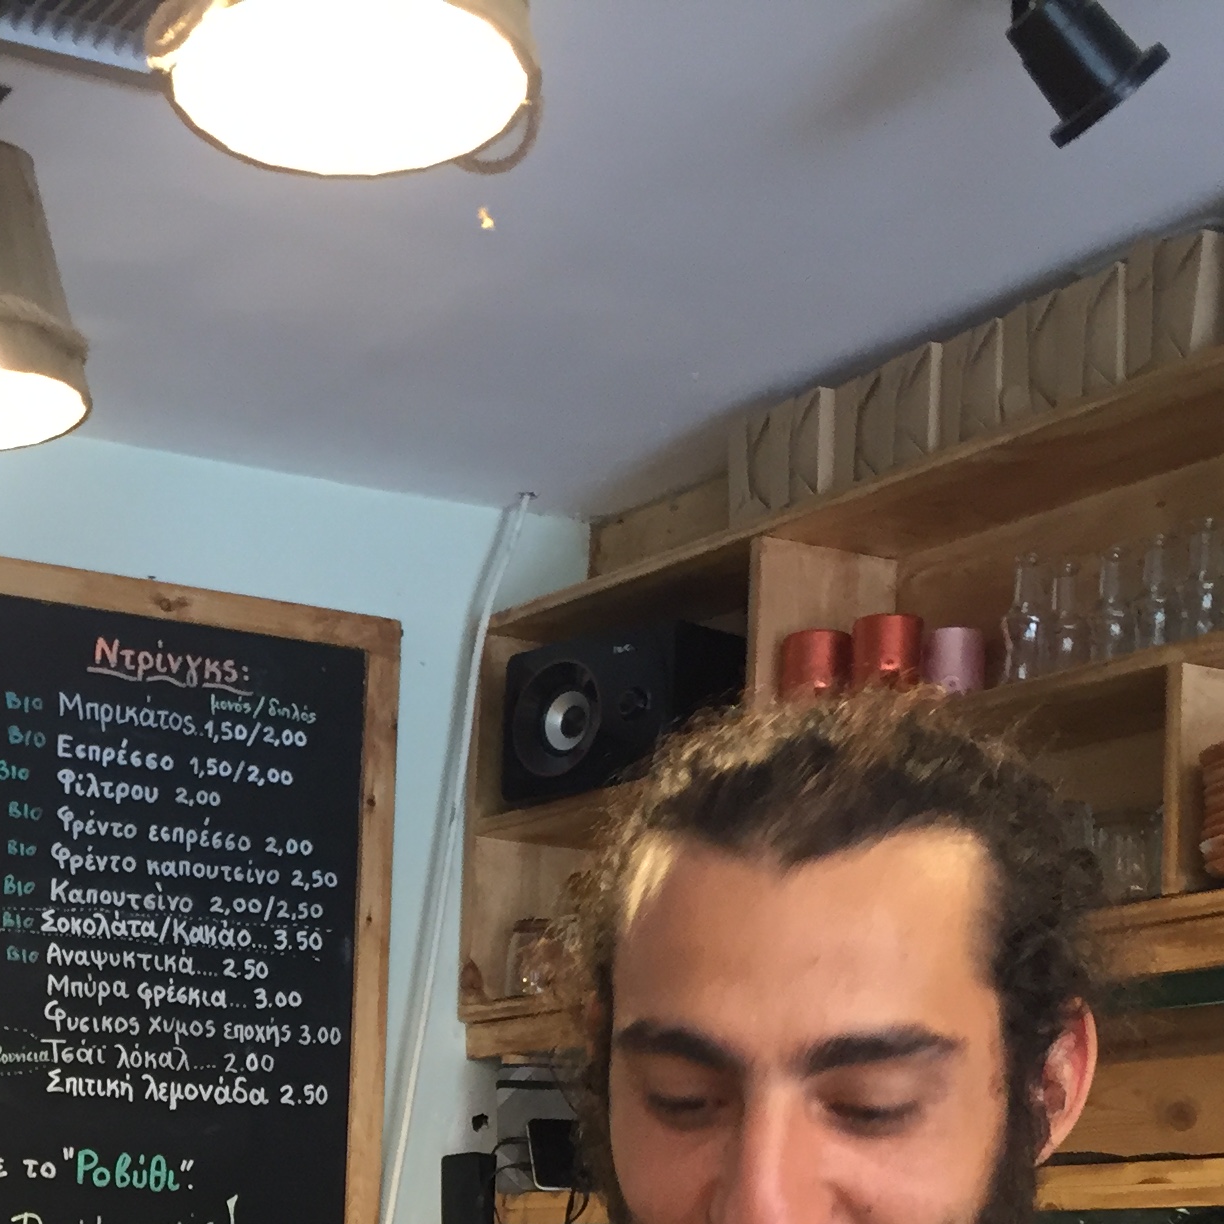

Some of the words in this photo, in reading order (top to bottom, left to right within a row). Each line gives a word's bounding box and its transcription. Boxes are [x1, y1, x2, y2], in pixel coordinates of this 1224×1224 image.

[57, 768, 158, 804] Φίλτρου
[47, 974, 130, 1005] Μπύρα
[46, 1068, 134, 1100] Σπιτική
[142, 1075, 269, 1111] λεμονάδα
[280, 1084, 328, 1105] 2.50
[23, 1159, 56, 1180] το
